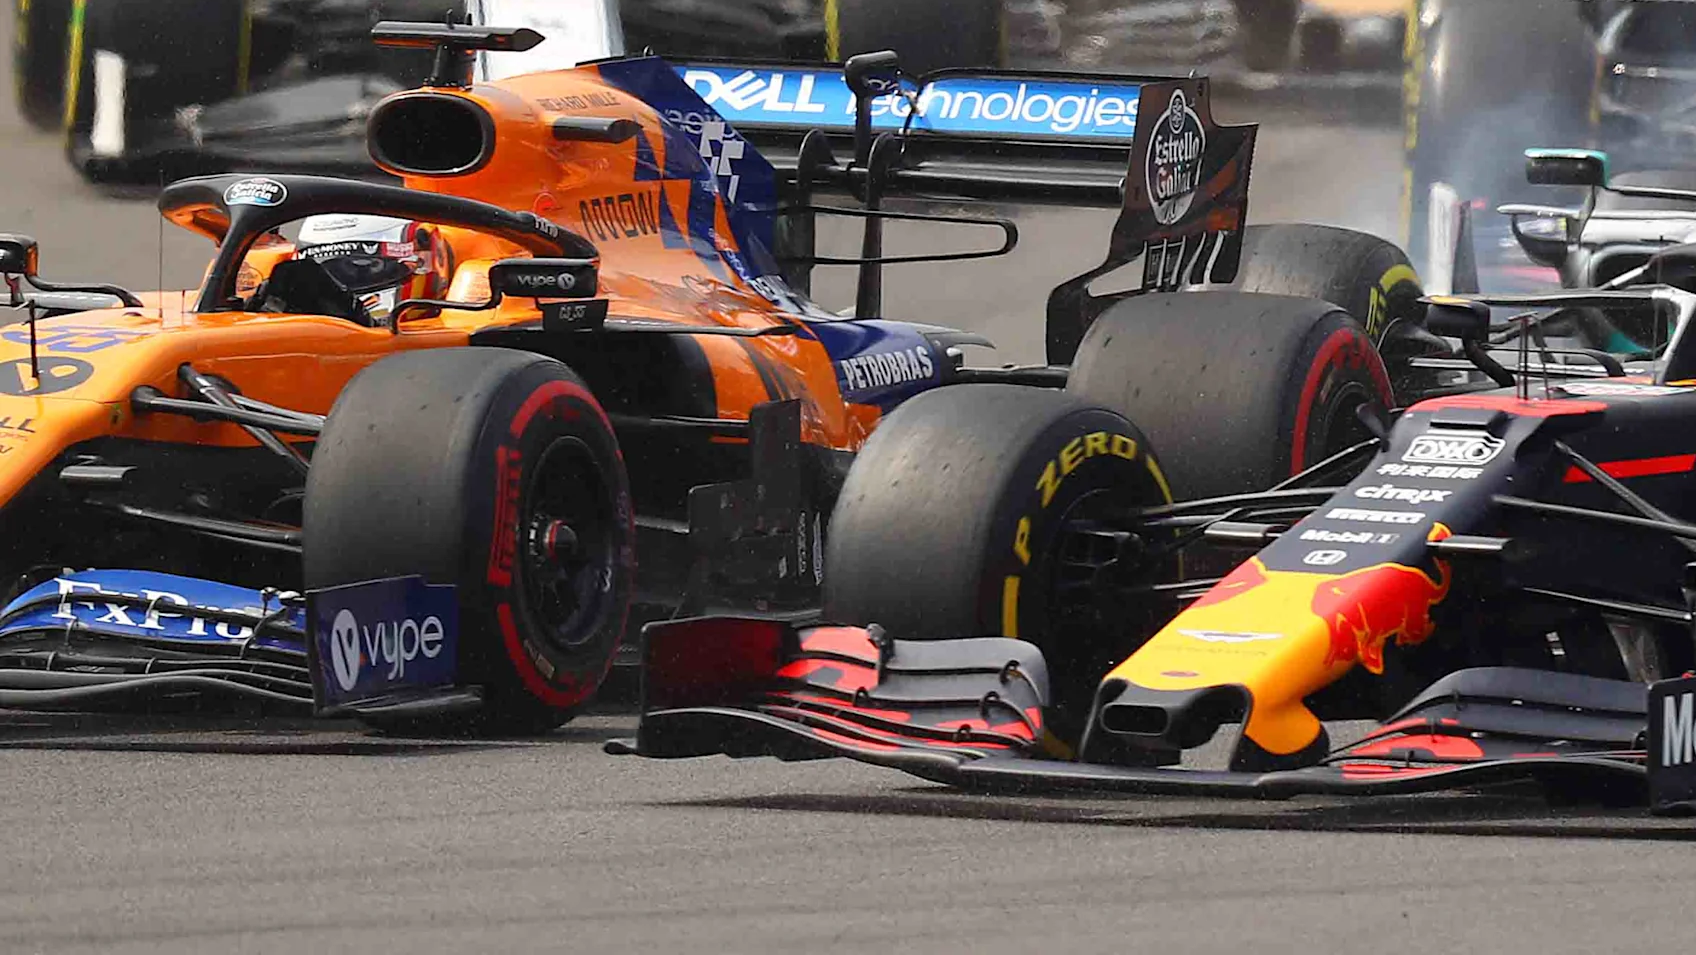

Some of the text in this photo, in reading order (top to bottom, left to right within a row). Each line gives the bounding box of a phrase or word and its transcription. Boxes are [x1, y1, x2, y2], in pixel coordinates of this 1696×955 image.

[583, 91, 621, 107] MILLE
[684, 67, 826, 115] DELL
[517, 275, 557, 288] vype
[840, 344, 934, 391] PETROBRAS
[1035, 431, 1138, 509] ZERO
[1409, 439, 1497, 462] OXXO
[1013, 516, 1031, 566] P
[1299, 529, 1373, 543] Mobil
[363, 615, 445, 681] vype
